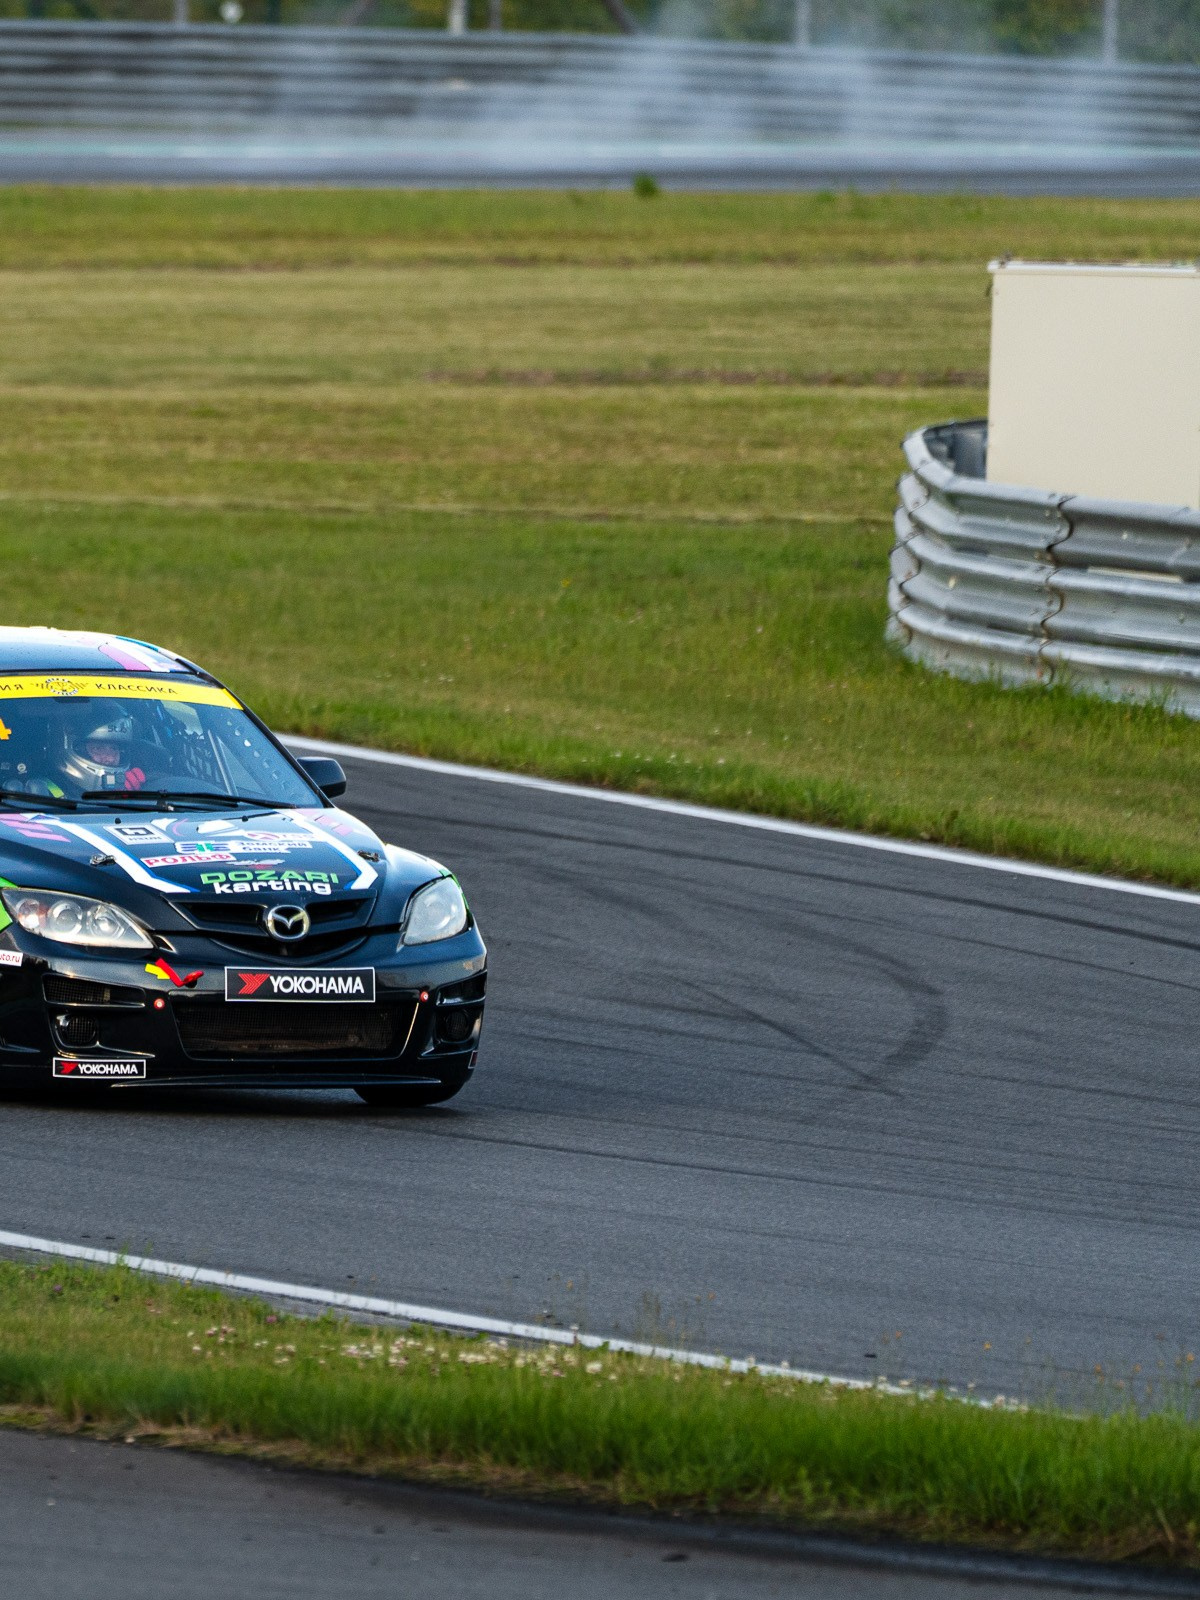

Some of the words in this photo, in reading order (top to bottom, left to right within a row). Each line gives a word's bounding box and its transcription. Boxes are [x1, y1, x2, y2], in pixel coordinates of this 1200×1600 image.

[95, 683, 178, 694] КЛАССИКА
[144, 854, 232, 866] РОЛЬФ
[200, 870, 339, 884] DOZARI
[213, 879, 332, 895] karting
[270, 975, 365, 995] YOKOHAMA
[77, 1063, 139, 1075] YOKOHAMA
